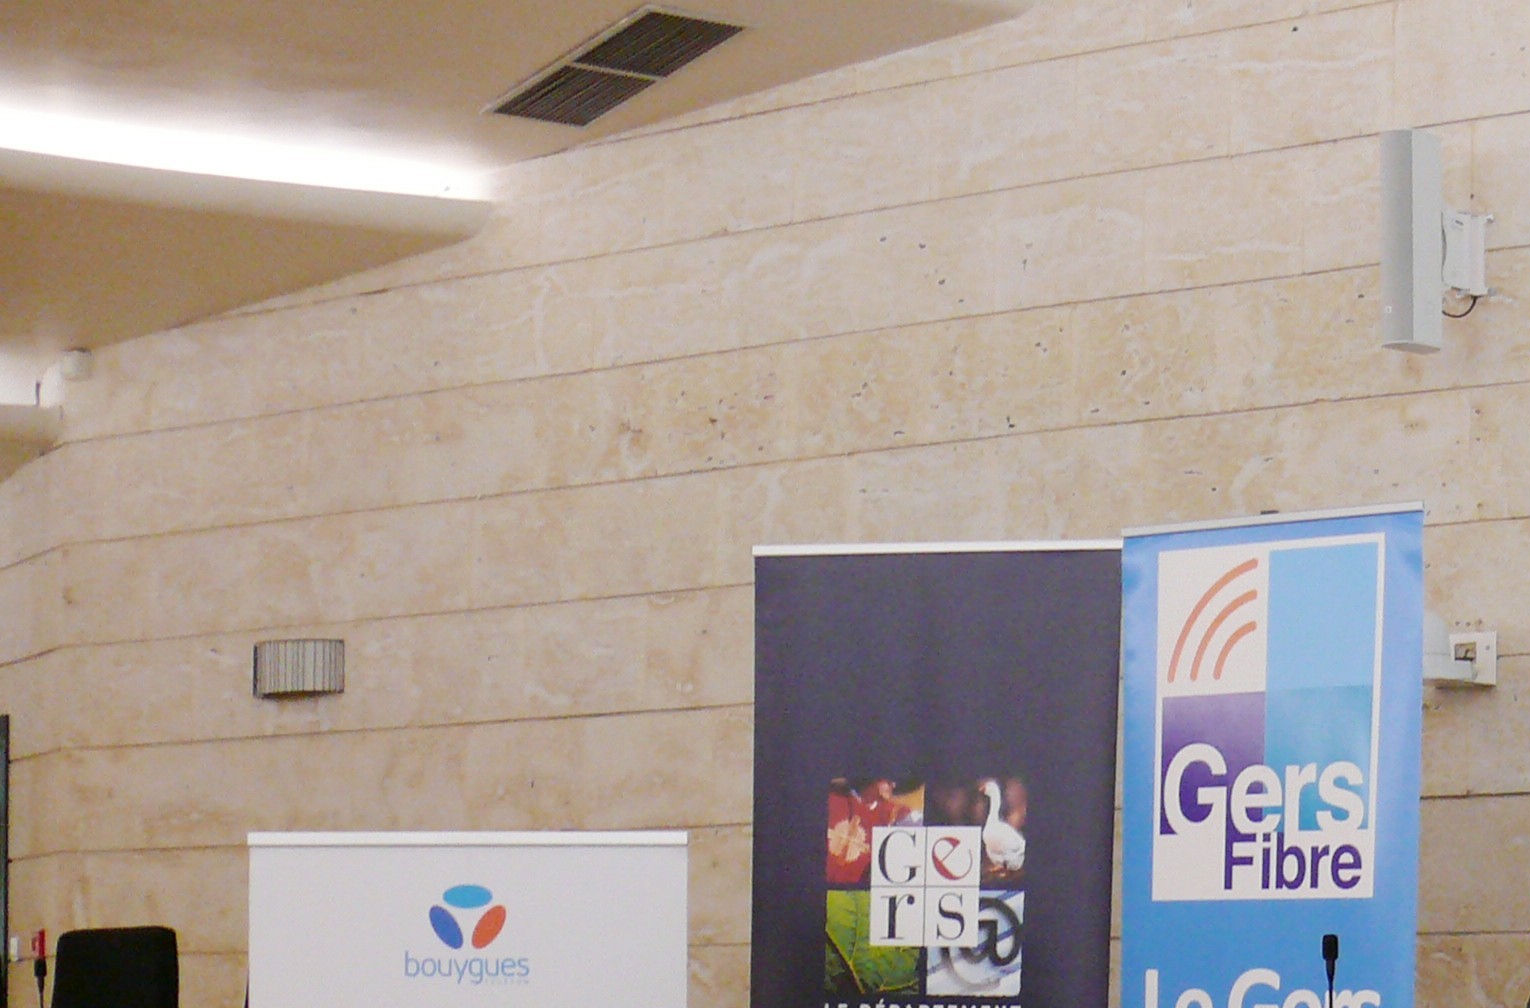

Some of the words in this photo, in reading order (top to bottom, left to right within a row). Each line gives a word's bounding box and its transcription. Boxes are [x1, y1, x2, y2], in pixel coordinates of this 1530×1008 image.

[1162, 742, 1366, 837] Gers
[1223, 829, 1363, 891] Fibre
[404, 950, 530, 985] bouygues
